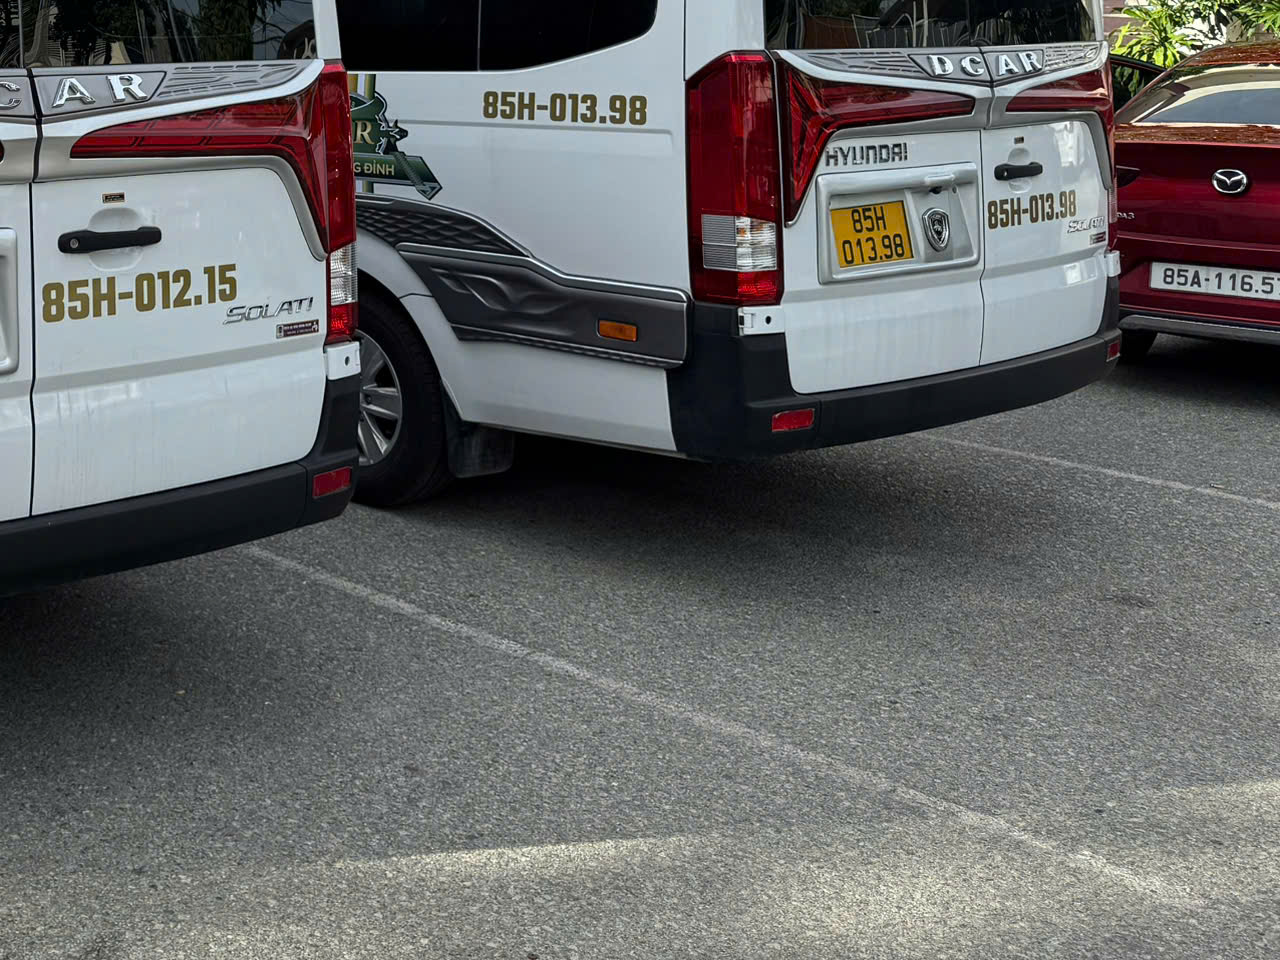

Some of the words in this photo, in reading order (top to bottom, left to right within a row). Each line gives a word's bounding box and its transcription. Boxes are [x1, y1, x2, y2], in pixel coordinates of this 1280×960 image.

[926, 50, 1043, 77] DCAR
[482, 90, 648, 126] 85H-013.98
[825, 142, 909, 167] HYUNDAI
[852, 205, 887, 234] 85H
[987, 189, 1078, 230] 85H-013.98
[842, 232, 906, 266] 013.98
[40, 262, 239, 324] 85H-012.15
[1162, 267, 1280, 295] 85A-116.5
[222, 296, 314, 326] SOLATI
